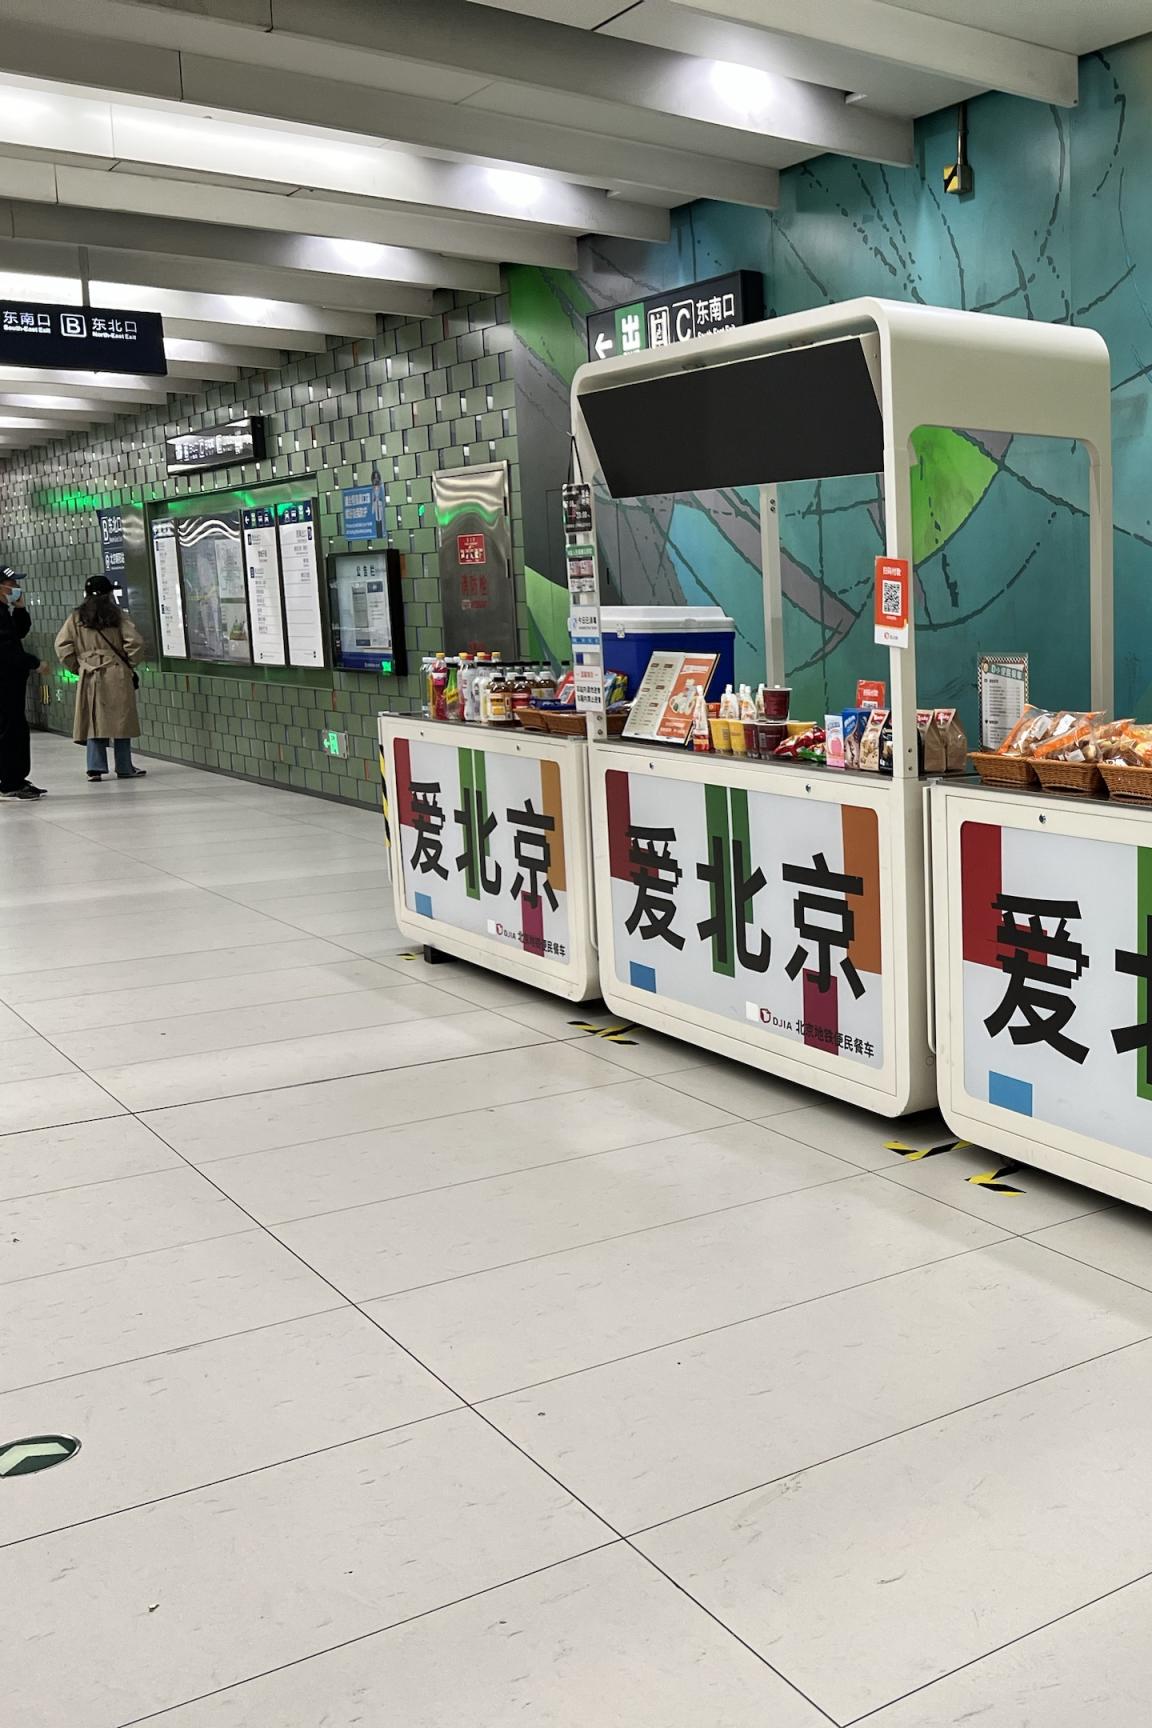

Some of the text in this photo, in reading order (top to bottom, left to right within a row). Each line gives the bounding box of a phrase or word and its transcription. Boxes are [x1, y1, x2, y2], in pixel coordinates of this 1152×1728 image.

[3, 311, 51, 327] 东南口
[67, 318, 81, 334] B
[91, 318, 138, 333] 东北口
[676, 307, 692, 341] C
[696, 293, 735, 325] 东南口
[621, 314, 641, 350] 出
[408, 781, 559, 912] 爱北京
[625, 825, 866, 999] 爱北京
[773, 1016, 874, 1058] DJIA 北京地铁便民餐车
